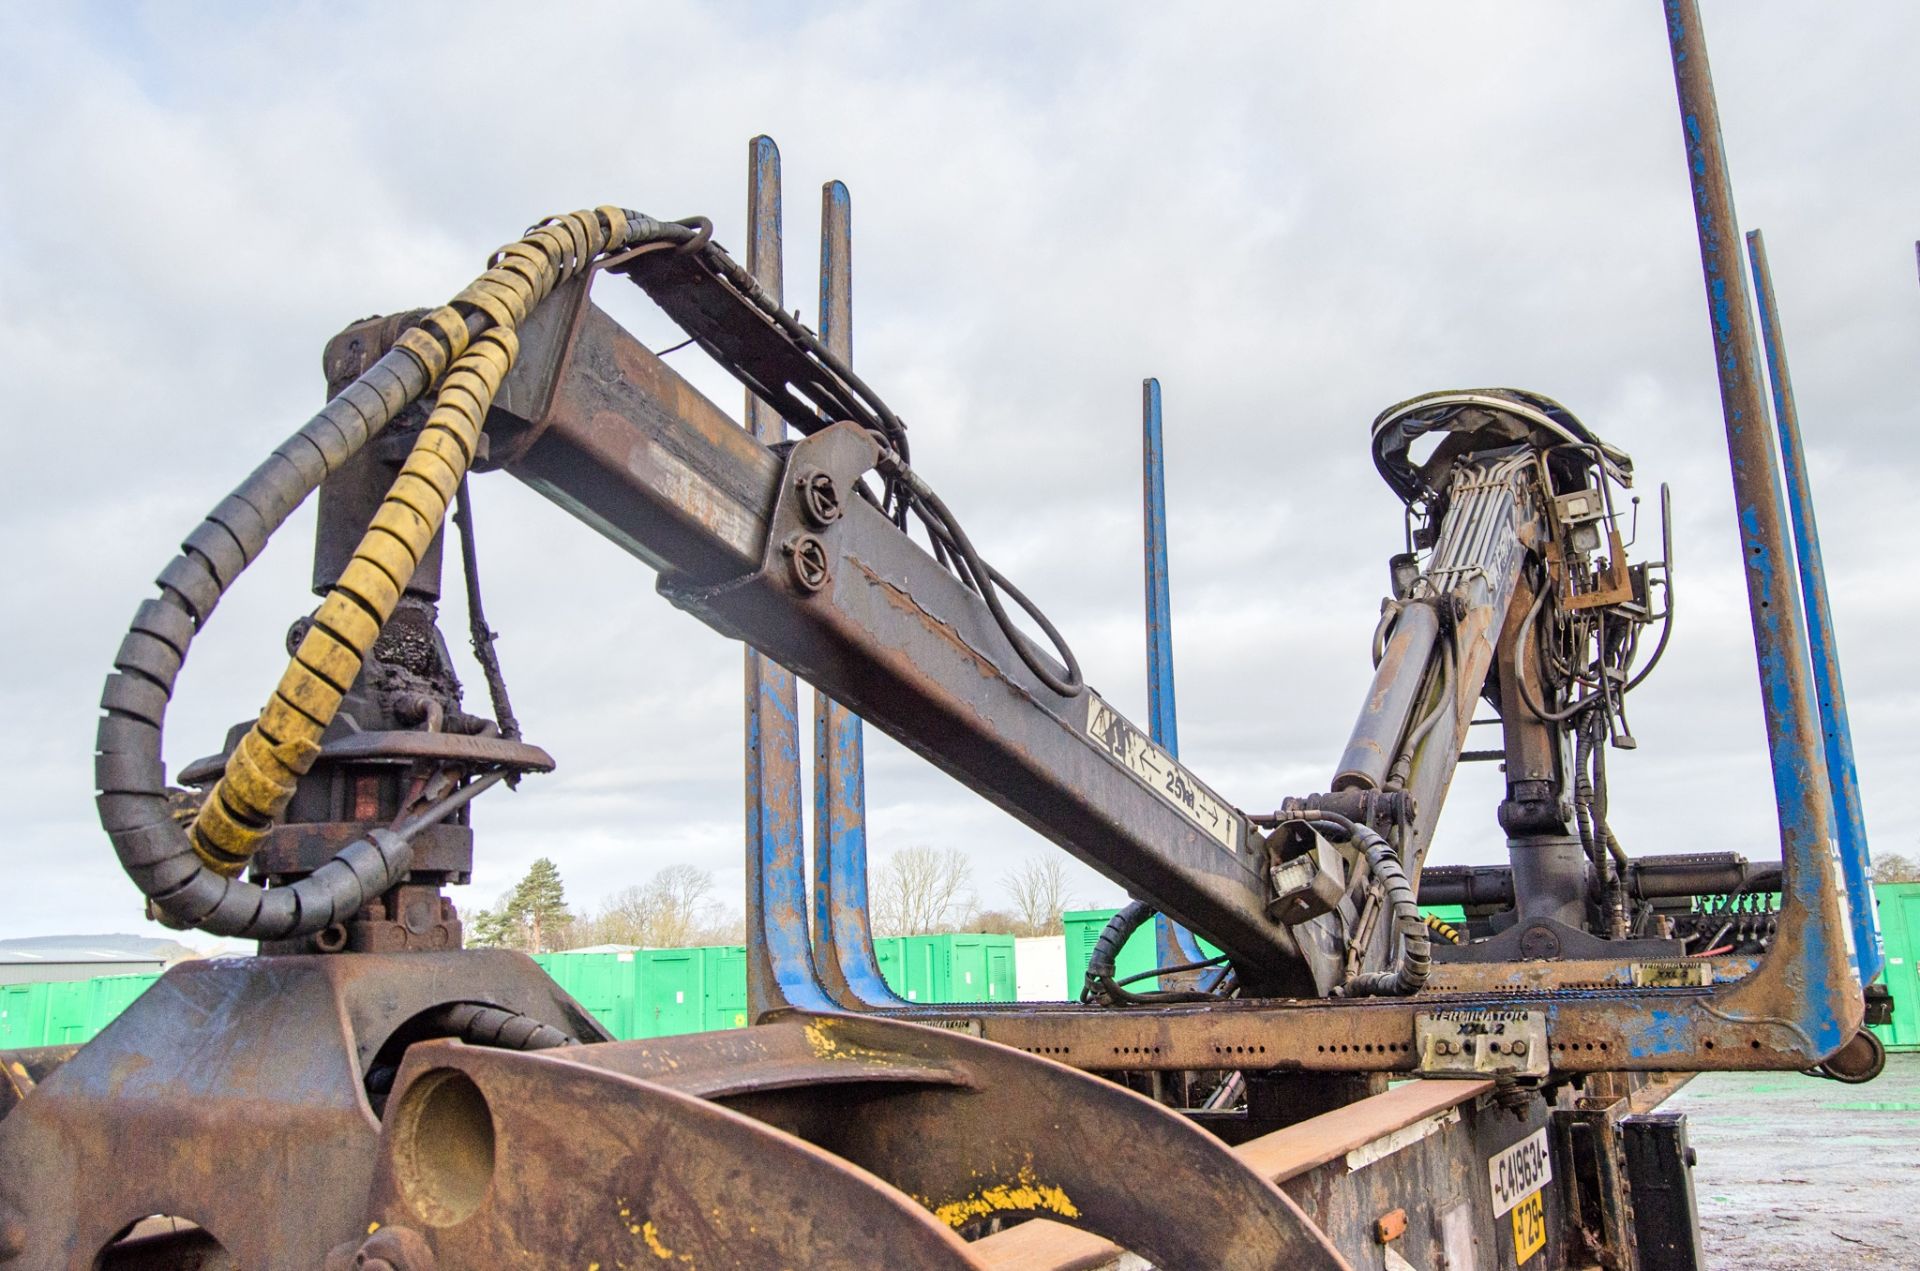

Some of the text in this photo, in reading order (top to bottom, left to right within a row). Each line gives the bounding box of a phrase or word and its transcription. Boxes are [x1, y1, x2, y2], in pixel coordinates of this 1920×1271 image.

[1430, 1010, 1529, 1022] TERMINATOR
[1457, 1023, 1505, 1034] XXL 2
[1498, 1137, 1544, 1203] C419634
[1517, 1198, 1541, 1250] T29
